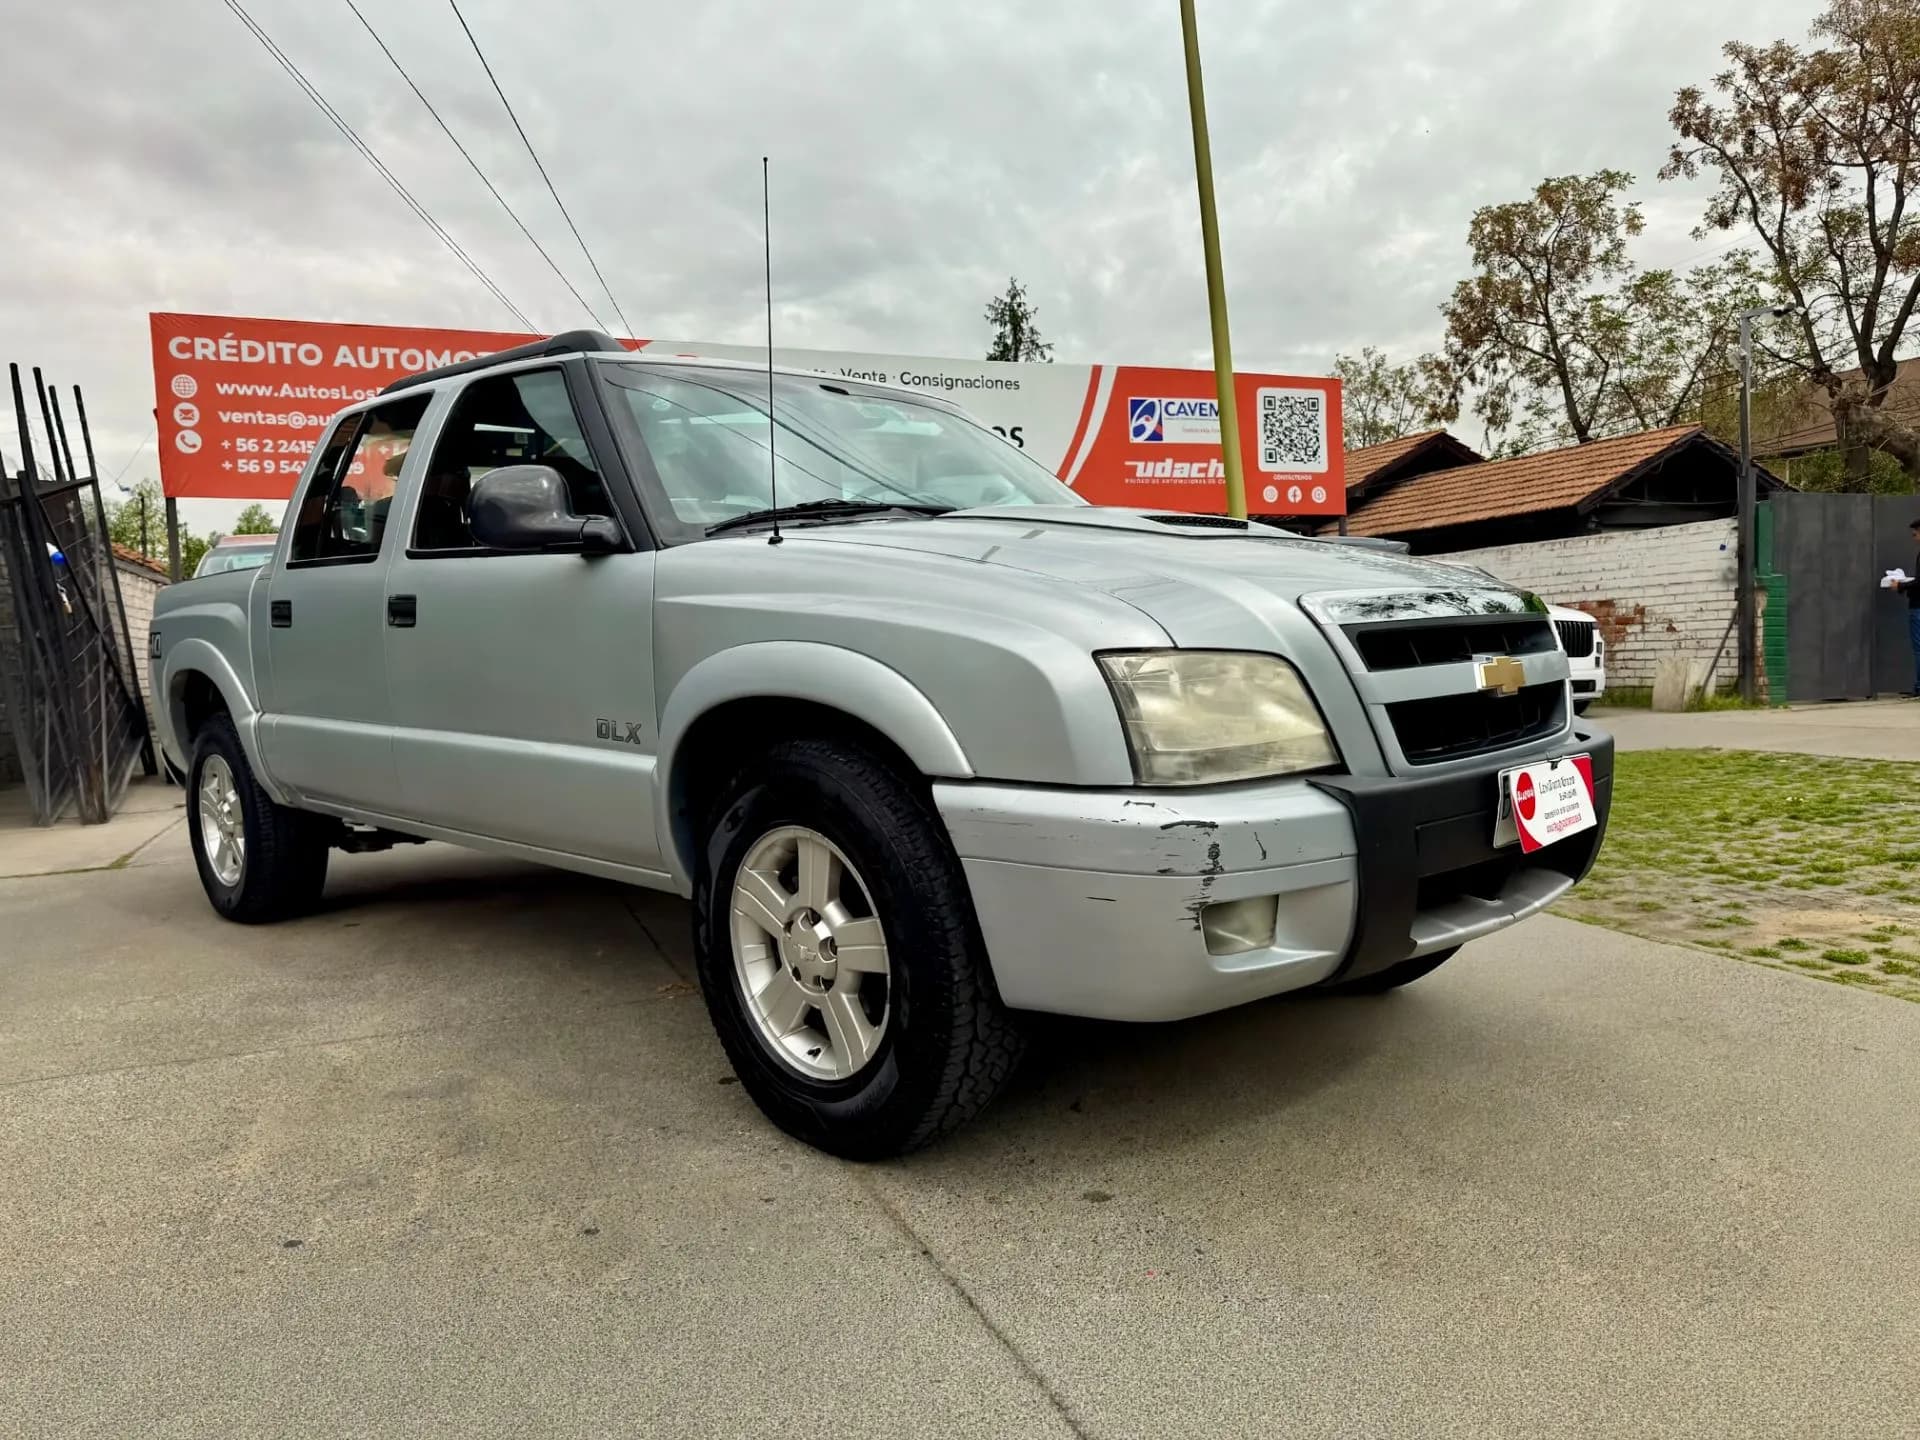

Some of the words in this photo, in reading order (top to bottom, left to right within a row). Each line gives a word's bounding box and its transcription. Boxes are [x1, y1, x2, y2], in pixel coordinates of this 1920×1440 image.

[168, 332, 323, 366] CRÉDITO
[333, 345, 496, 371] AUTOMO
[900, 371, 1020, 390] Consignaciones
[216, 383, 384, 400] www.AutosLos
[218, 411, 336, 429] ventas@au
[236, 438, 259, 452] 56
[263, 439, 275, 453] 2
[278, 440, 316, 454] 2415
[237, 459, 260, 473] 56
[264, 460, 275, 474] 9
[596, 718, 641, 745] DLX
